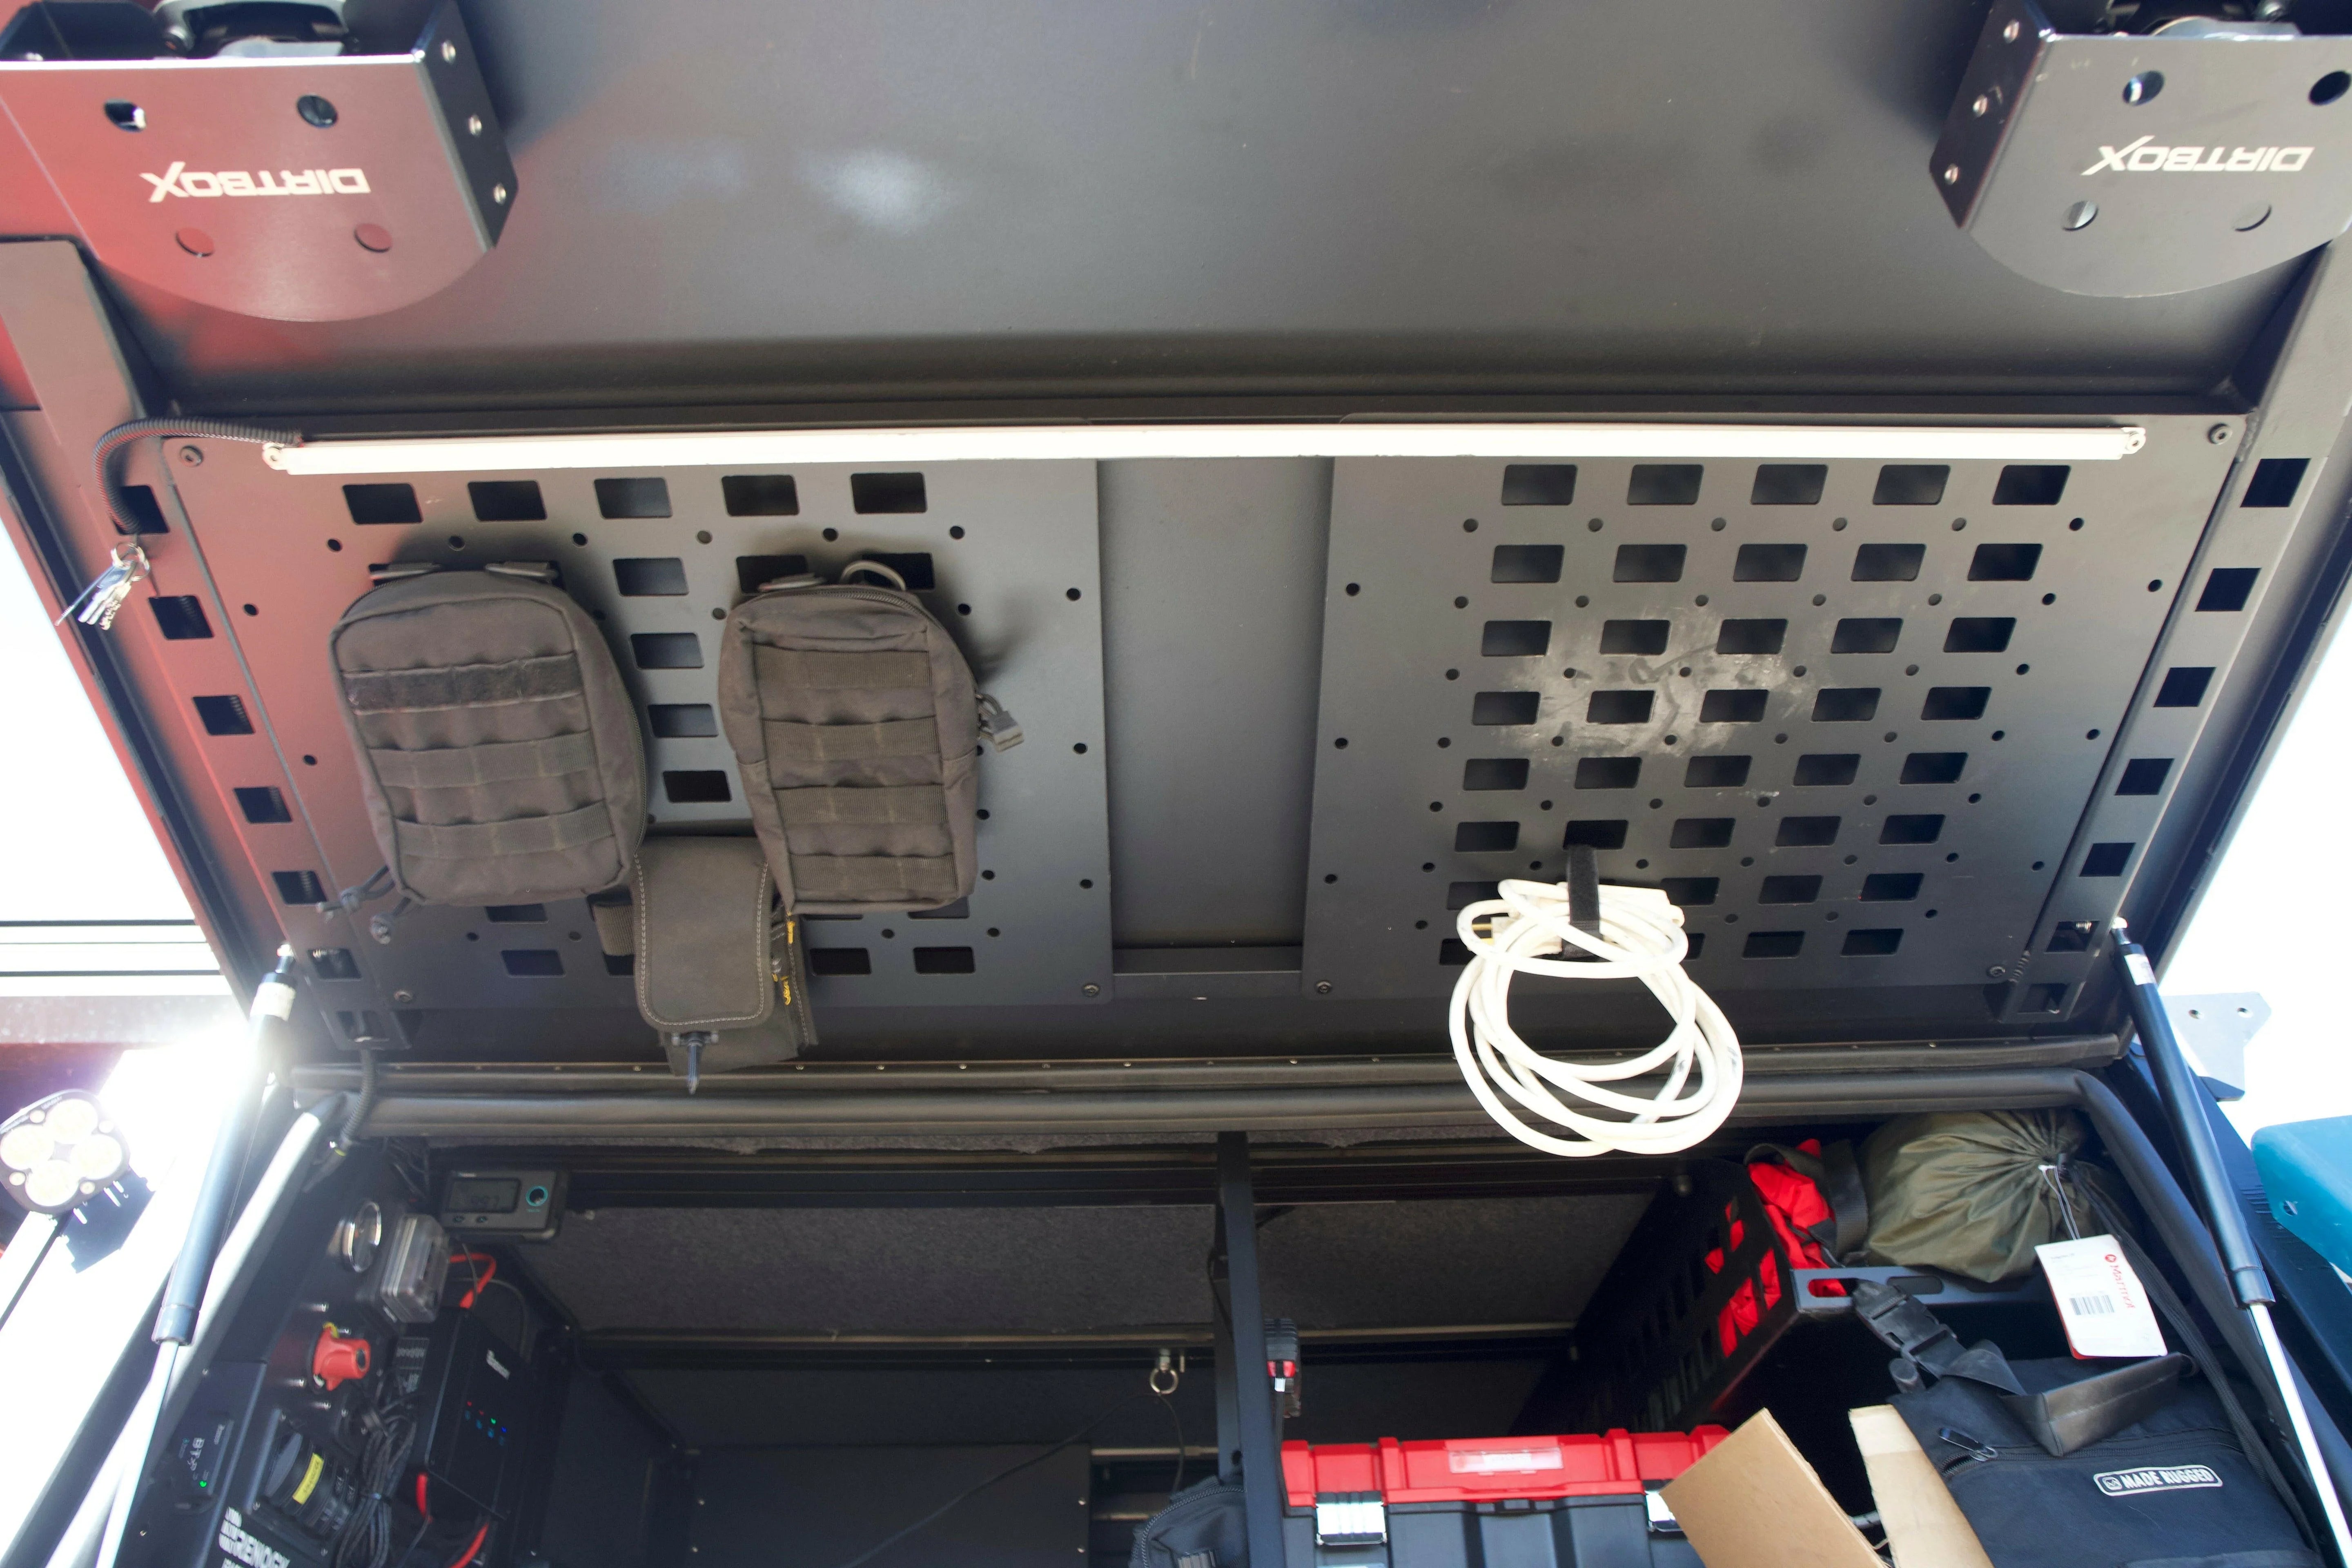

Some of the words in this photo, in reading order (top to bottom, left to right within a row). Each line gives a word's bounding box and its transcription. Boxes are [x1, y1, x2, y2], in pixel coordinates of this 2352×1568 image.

[2080, 135, 2315, 176] DIRTBOX
[139, 161, 371, 203] DIRTBOX
[2109, 1265, 2136, 1308] Marmot
[2120, 1471, 2163, 1489] MADE
[2158, 1469, 2215, 1484] RUGGED
